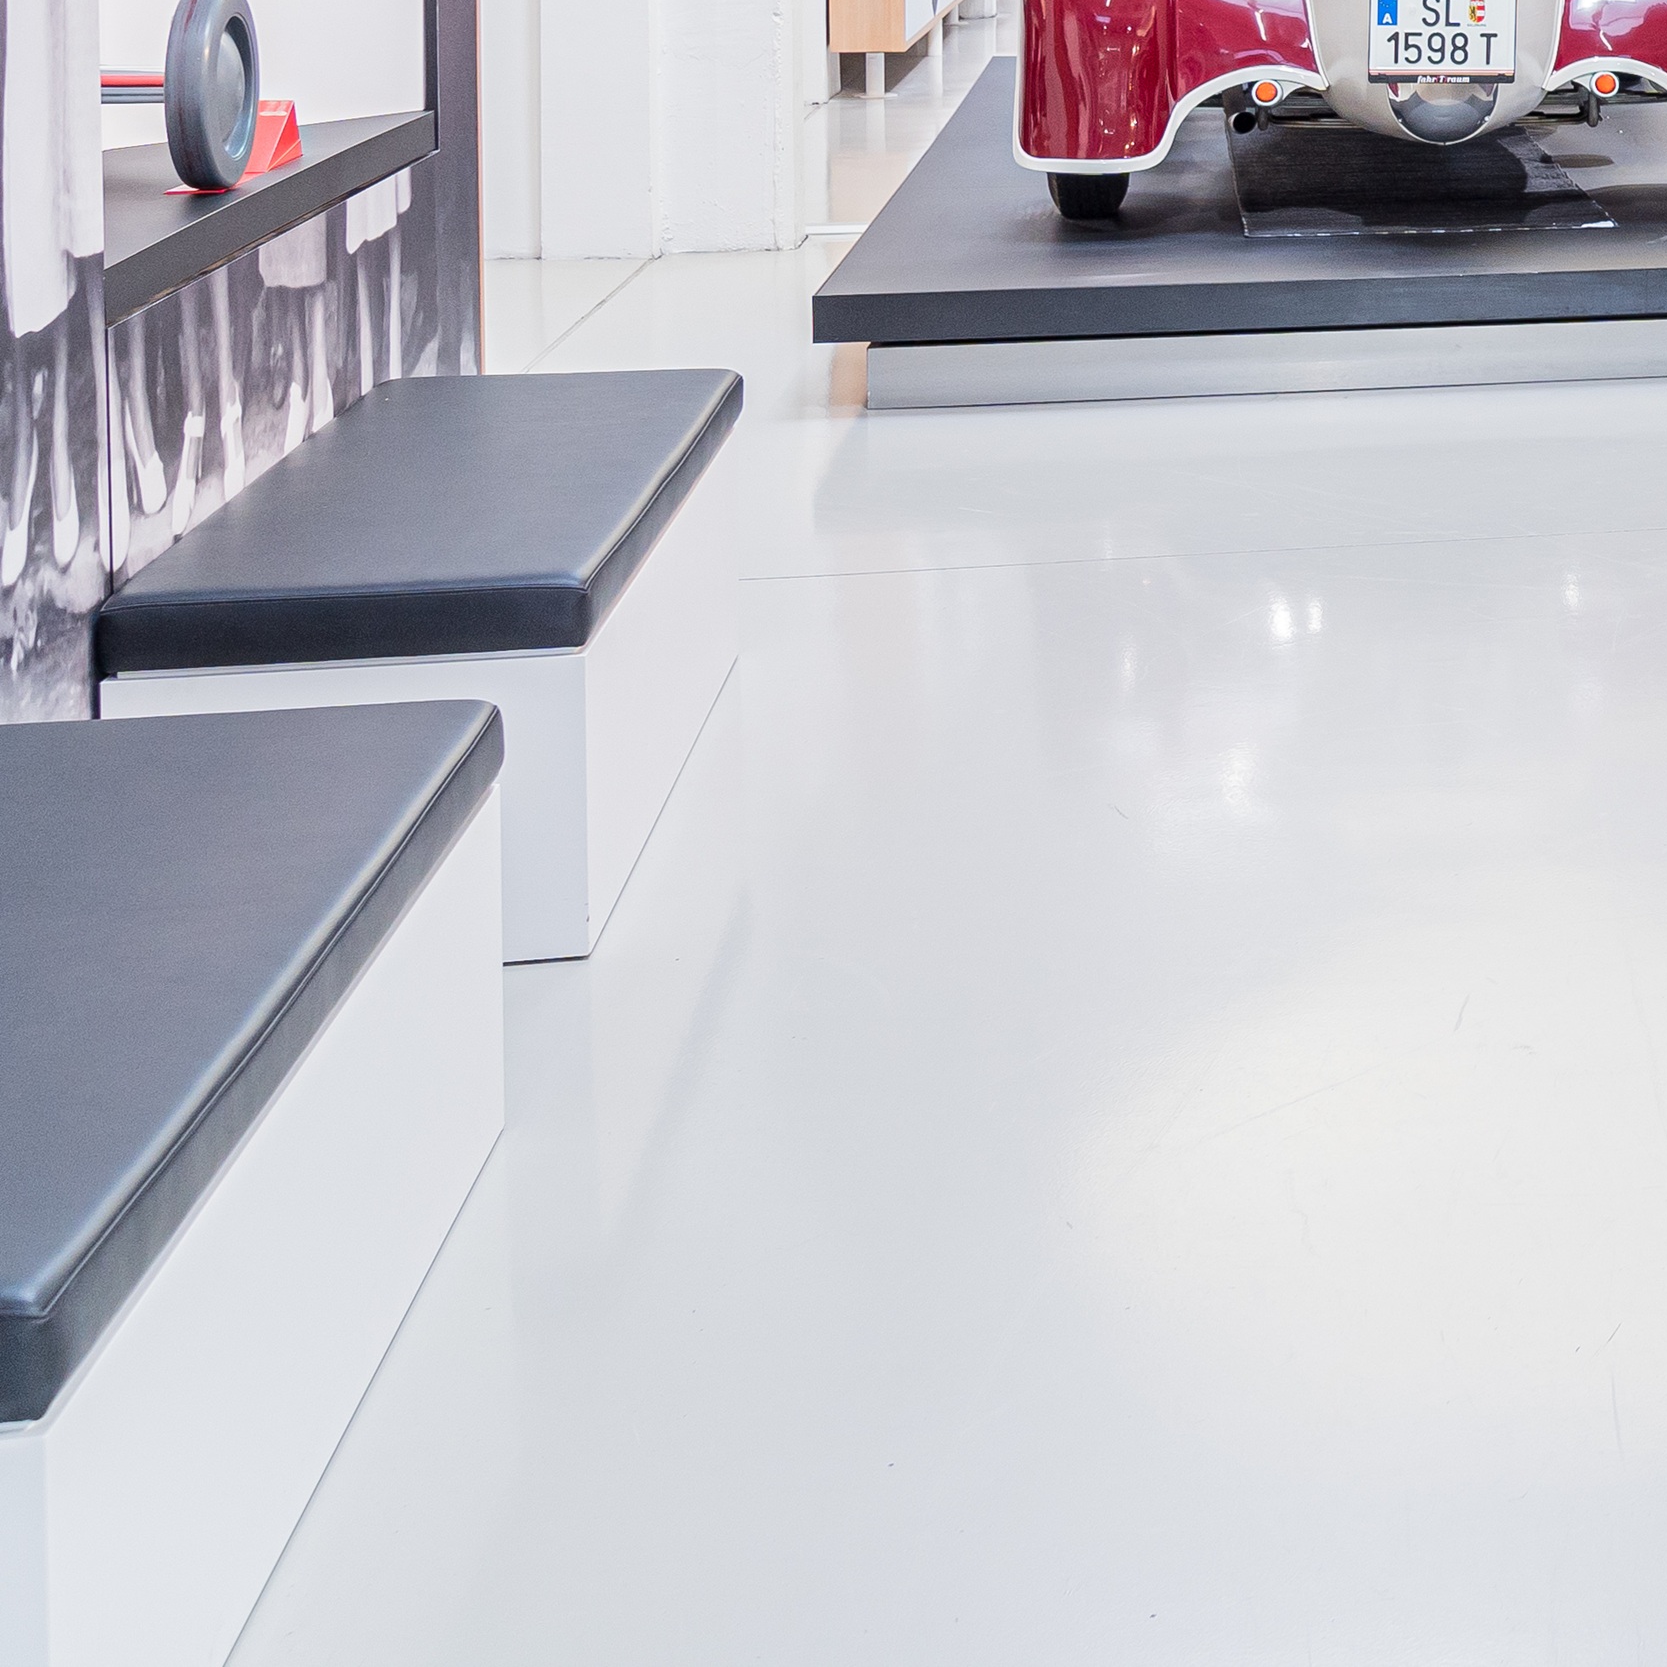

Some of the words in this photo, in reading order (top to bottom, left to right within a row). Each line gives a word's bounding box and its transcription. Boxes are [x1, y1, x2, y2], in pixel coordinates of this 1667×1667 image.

[1382, 13, 1393, 24] A
[1387, 32, 1468, 65] 1598
[1480, 33, 1497, 65] T
